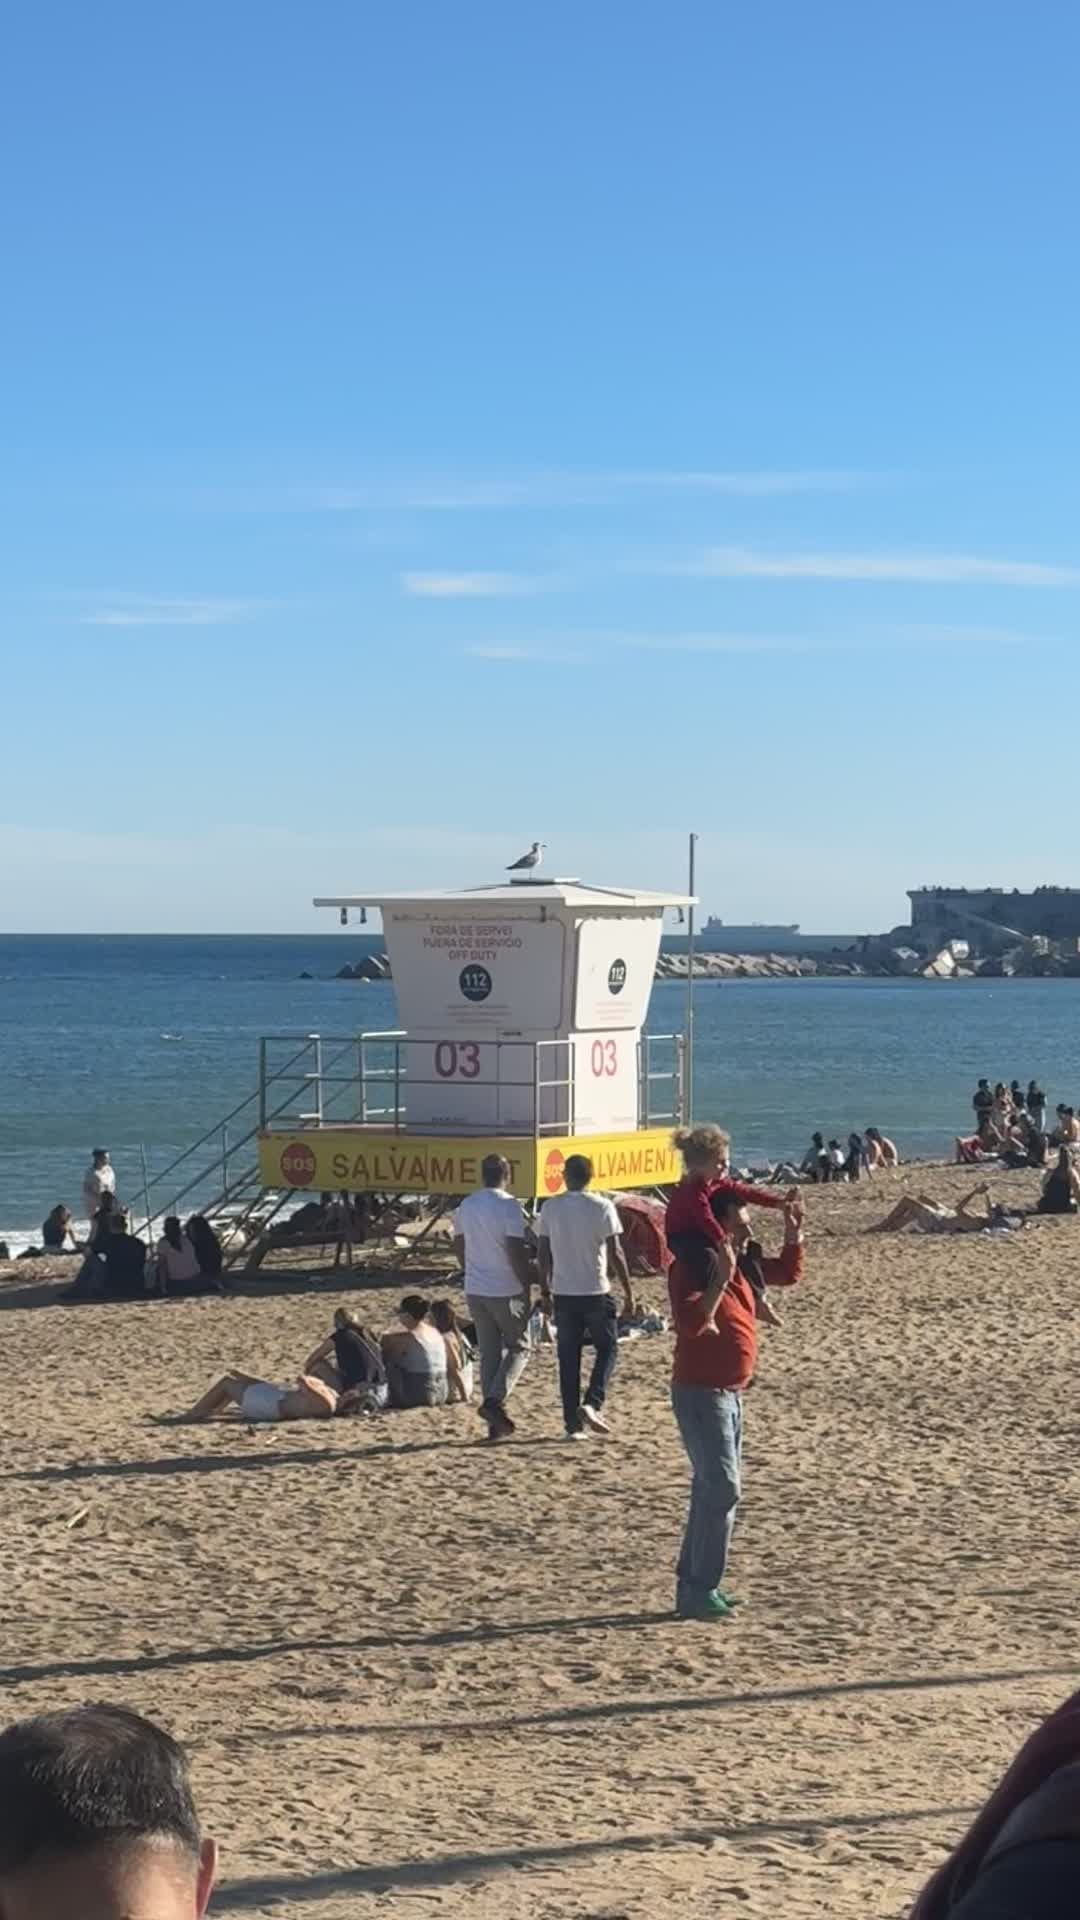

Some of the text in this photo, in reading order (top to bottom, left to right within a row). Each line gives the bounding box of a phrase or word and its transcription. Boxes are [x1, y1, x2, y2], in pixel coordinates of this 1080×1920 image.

[459, 925, 474, 936] DE
[423, 937, 522, 948] FUERA DE SERVICIO
[448, 950, 497, 960] OFF DUTY
[463, 973, 487, 986] 112
[611, 967, 625, 980] 112
[434, 1039, 481, 1078] 03
[591, 1039, 618, 1077] 03
[281, 1157, 314, 1171] SOS
[332, 1153, 521, 1185] SALVAMET
[580, 1148, 677, 1180] ALVAMENT
